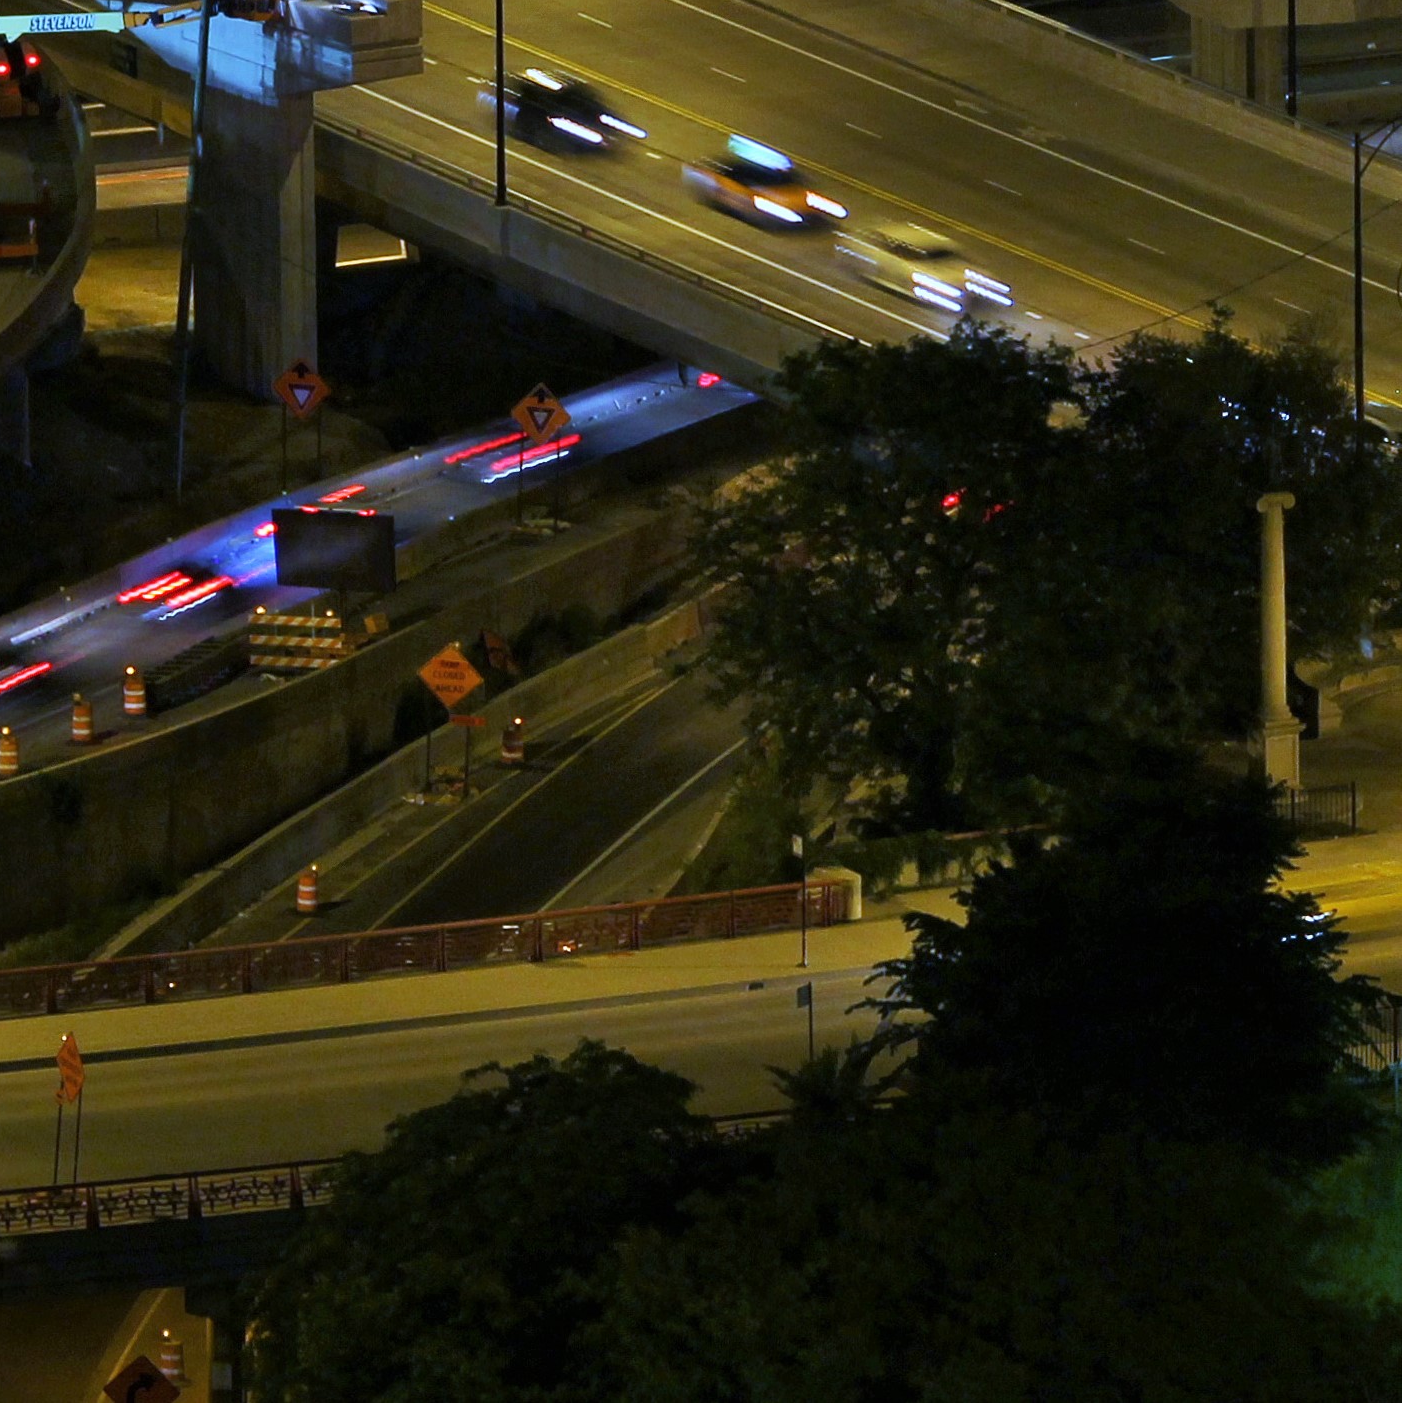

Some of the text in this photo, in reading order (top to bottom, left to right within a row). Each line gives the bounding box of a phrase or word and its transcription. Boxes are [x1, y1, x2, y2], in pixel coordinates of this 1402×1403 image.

[29, 14, 95, 31] STEVENSON
[432, 670, 466, 680] CLOSED
[435, 684, 465, 694] AHEAD
